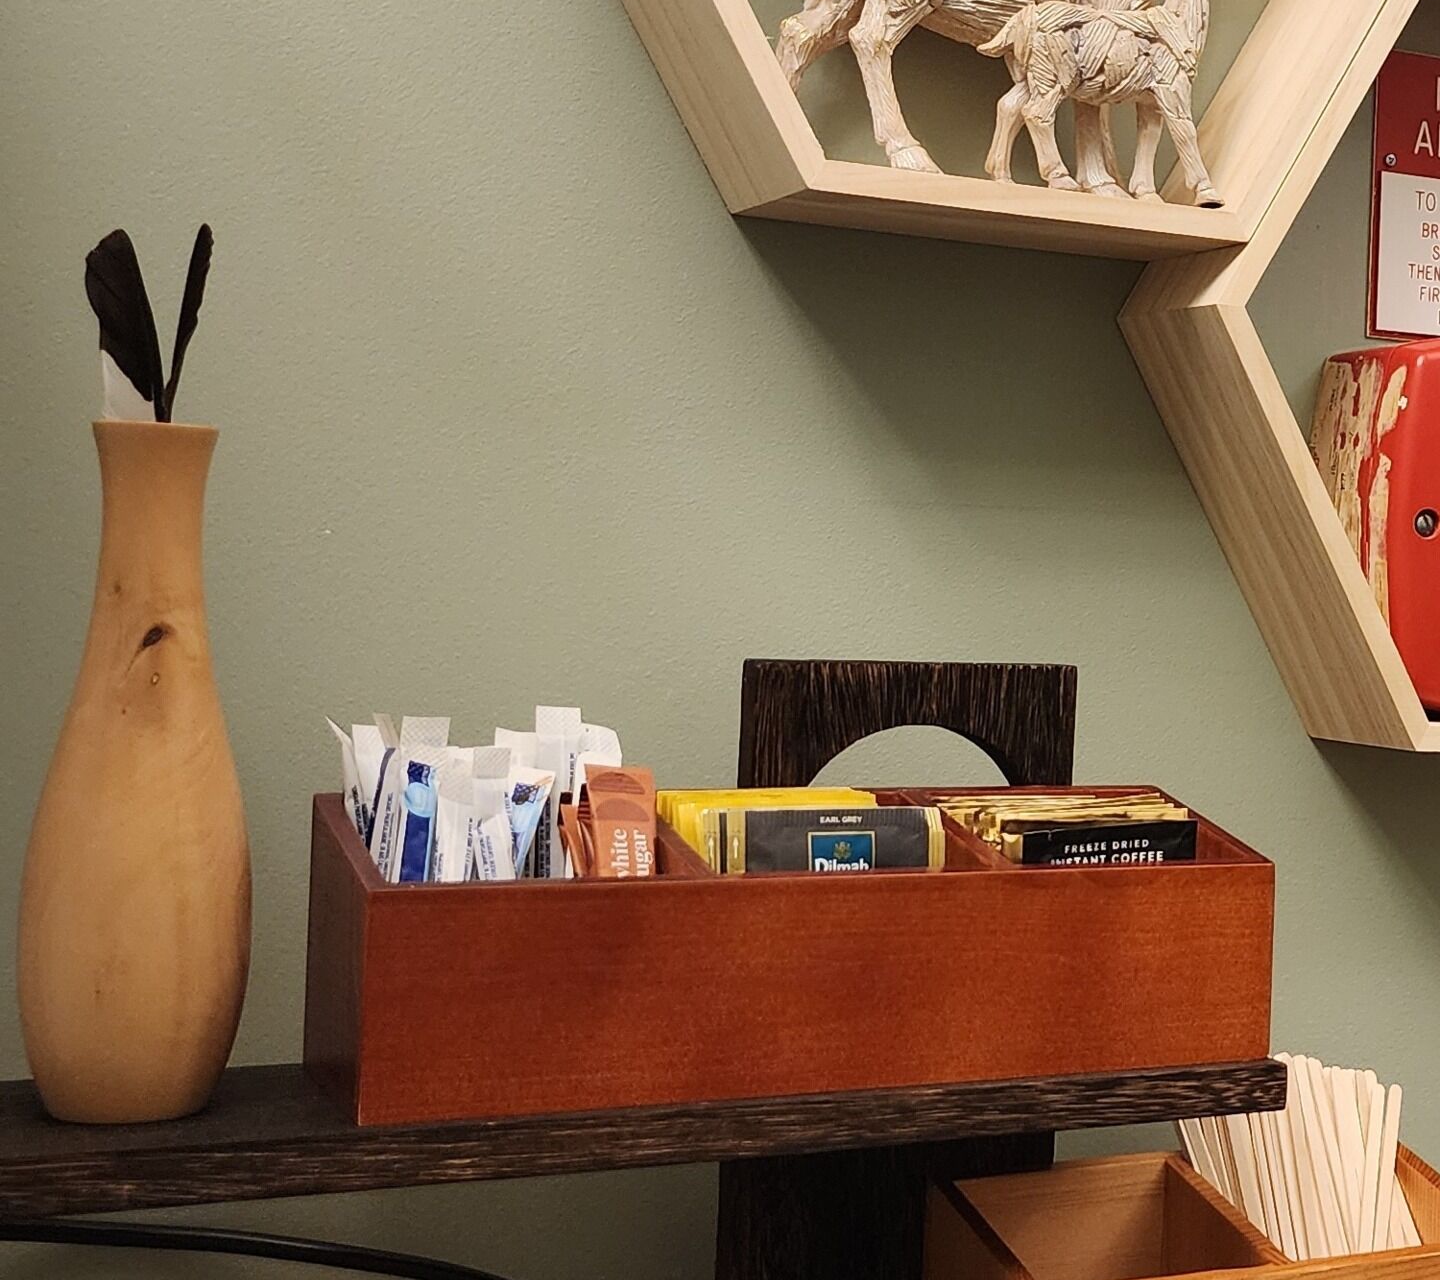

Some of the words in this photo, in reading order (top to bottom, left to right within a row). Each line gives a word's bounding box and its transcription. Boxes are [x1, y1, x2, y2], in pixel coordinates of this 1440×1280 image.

[1415, 190, 1436, 212] TO
[820, 815, 840, 824] EARL
[841, 815, 863, 824] GREY
[633, 829, 653, 877] ugar
[1064, 841, 1107, 854] FREEZE
[1112, 839, 1150, 850] DRIED
[1111, 850, 1164, 864] COFFEE
[814, 857, 870, 873] Dilmah
